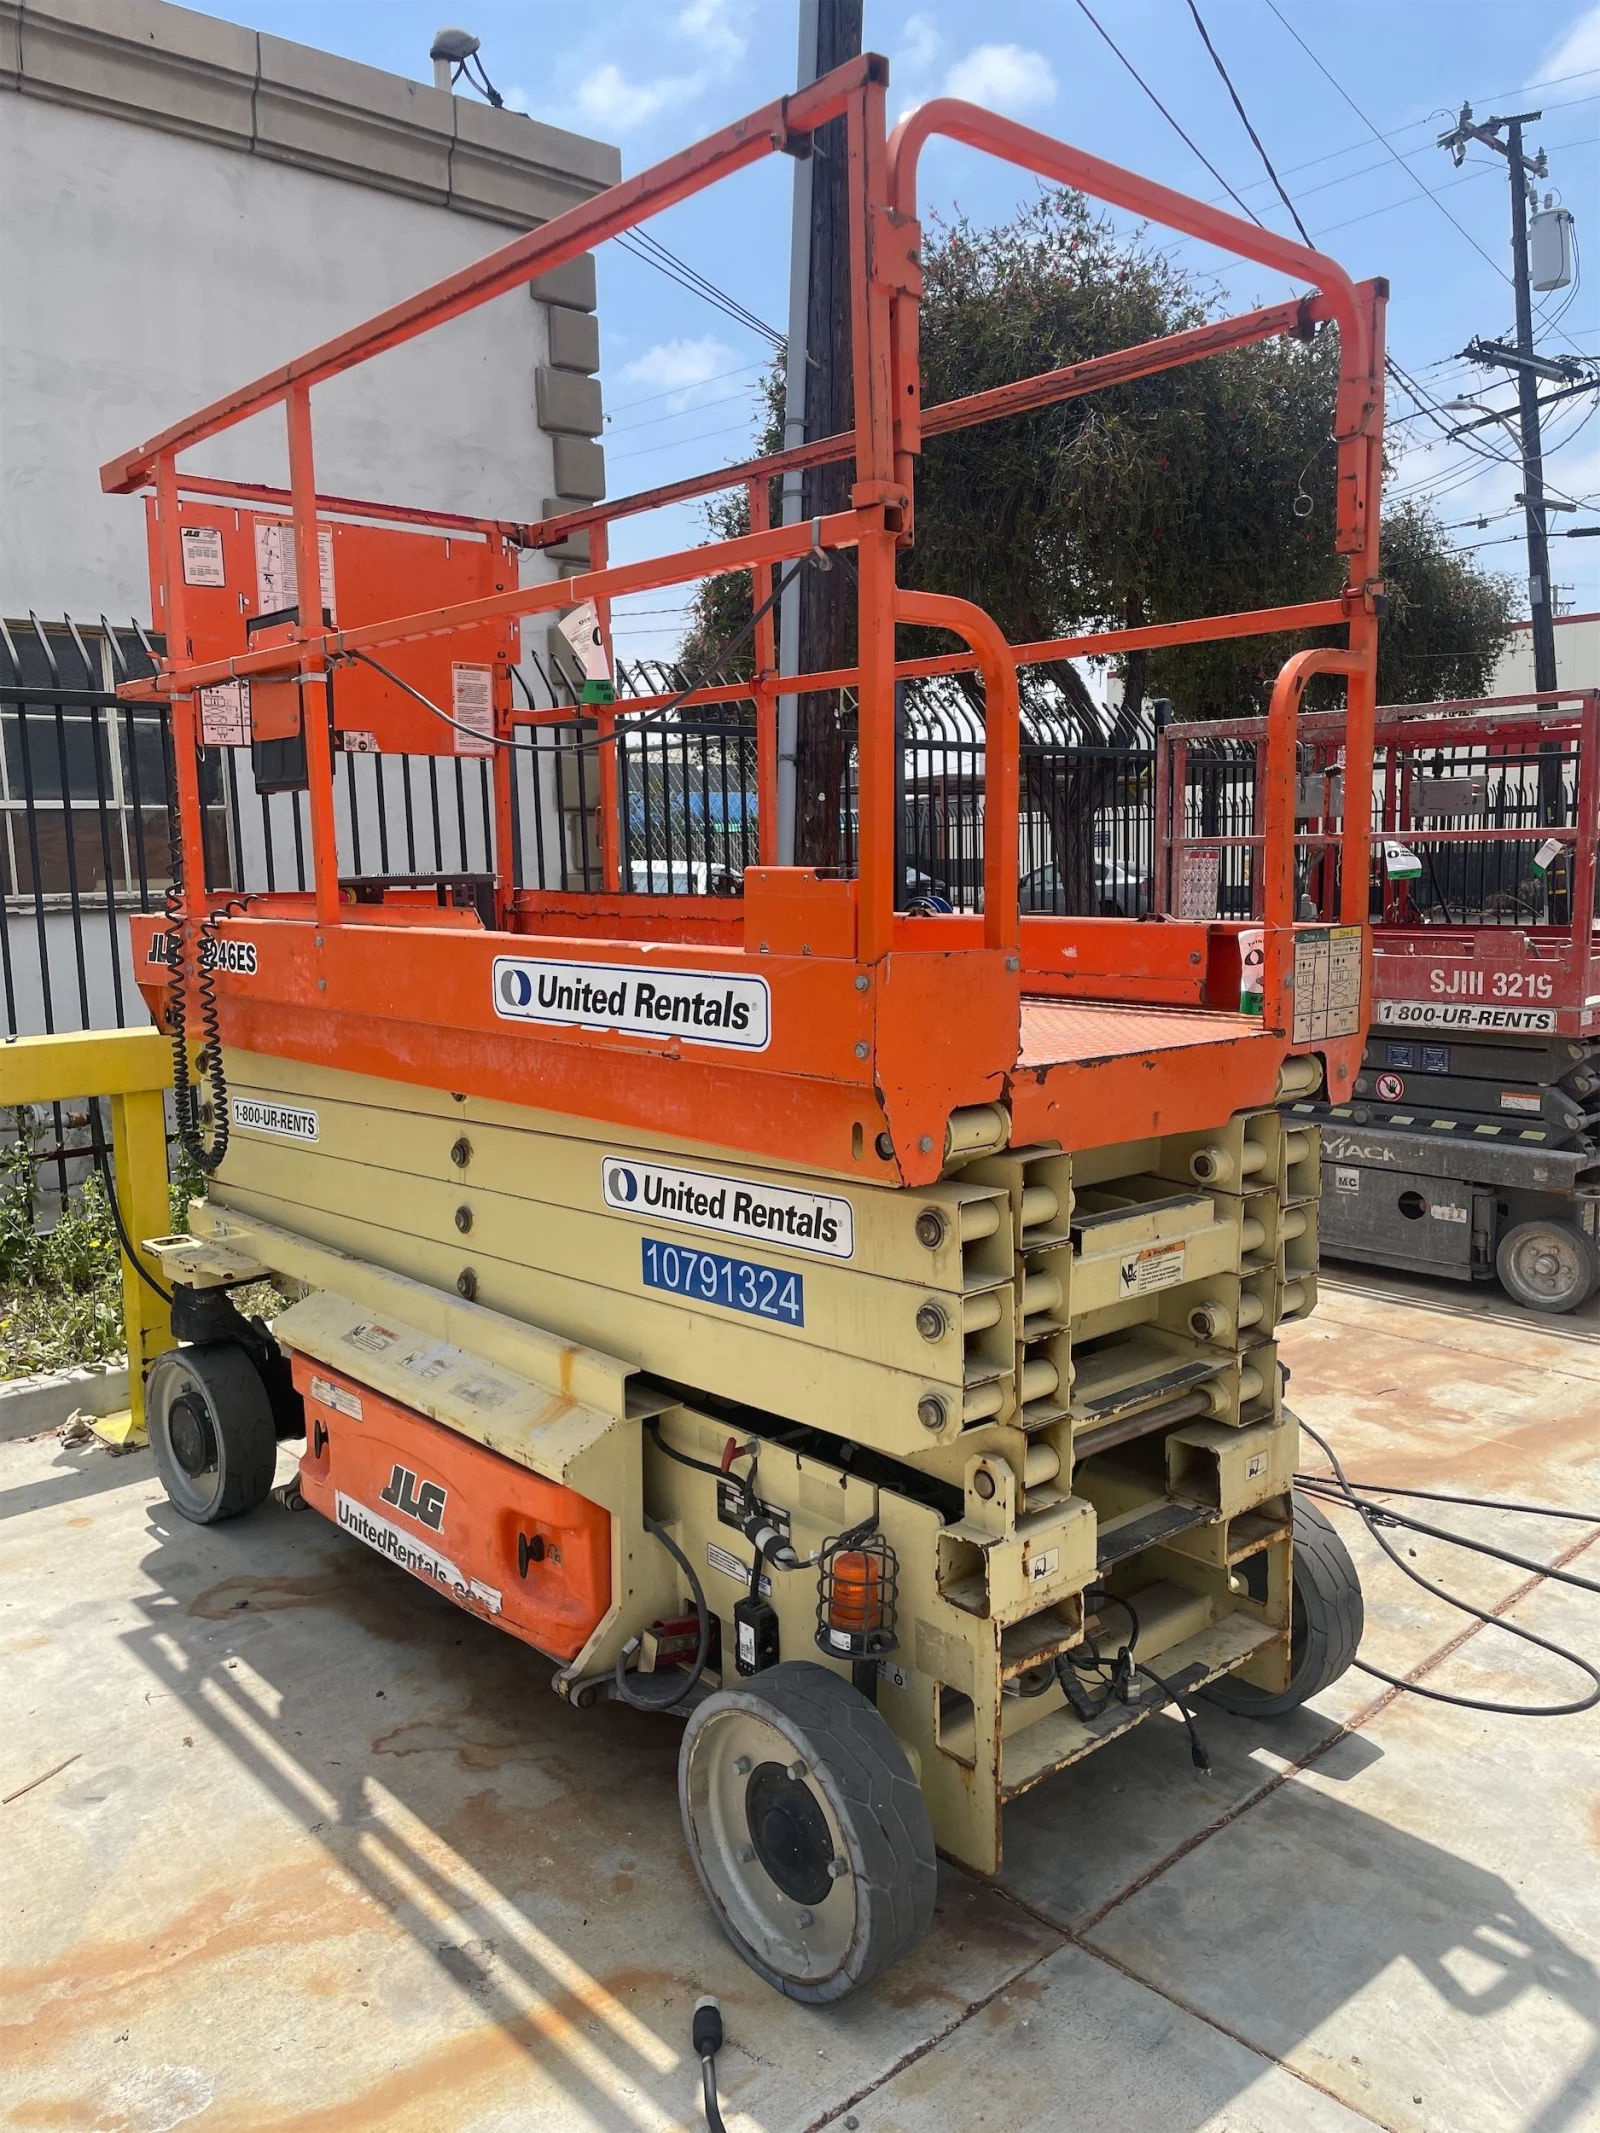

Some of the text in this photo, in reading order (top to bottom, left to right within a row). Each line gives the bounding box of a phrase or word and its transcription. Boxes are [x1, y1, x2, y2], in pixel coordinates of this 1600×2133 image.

[538, 974, 750, 1031] United Rentals
[1430, 969, 1484, 996] SJIII
[1383, 1004, 1551, 1030] 1800-UR-RENTS
[235, 1104, 315, 1135] 1-800-UR-RENTS
[1338, 1176, 1357, 1188] MC
[643, 1174, 838, 1243] United Rentals
[647, 1243, 800, 1320] 10791324
[380, 1464, 448, 1532] JLG
